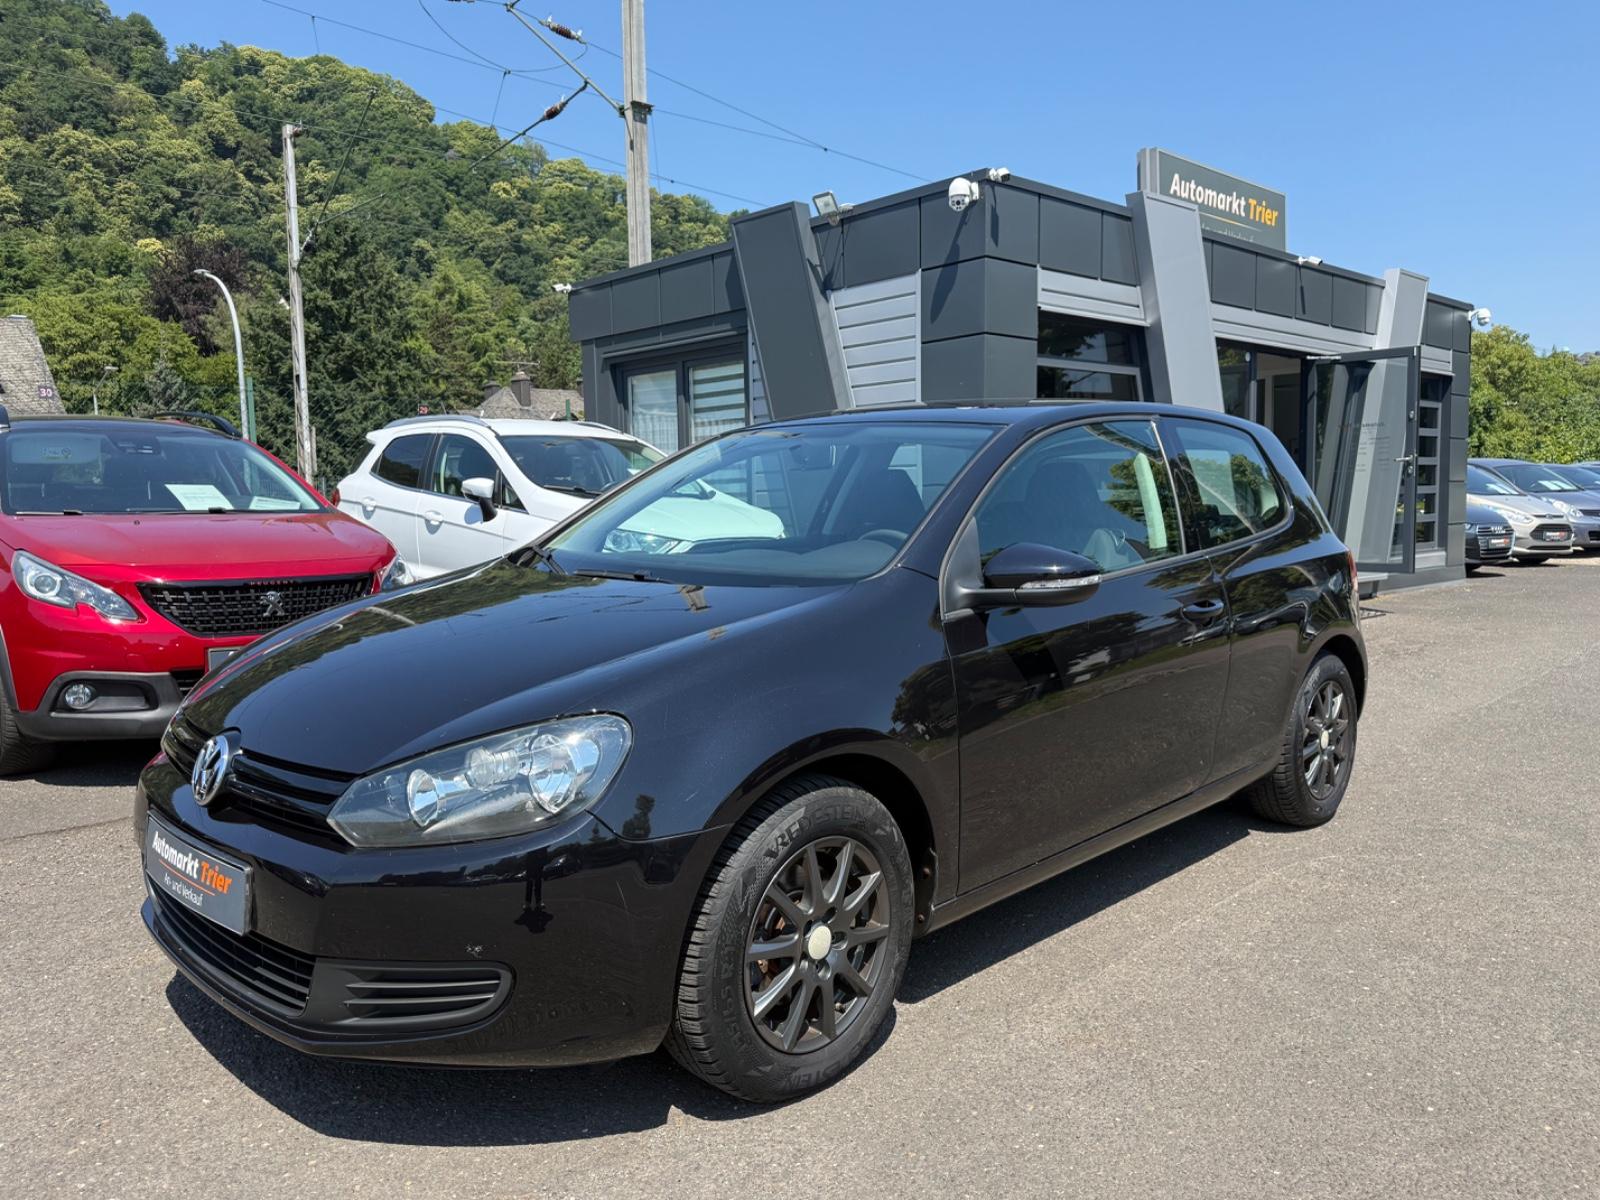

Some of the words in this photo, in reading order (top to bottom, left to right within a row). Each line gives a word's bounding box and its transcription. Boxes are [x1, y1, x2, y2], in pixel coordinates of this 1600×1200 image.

[1170, 173, 1245, 217] Automarkt
[1248, 198, 1278, 227] Trier
[39, 388, 53, 397] 30
[152, 831, 199, 879] Automarkt
[201, 861, 233, 894] Trier
